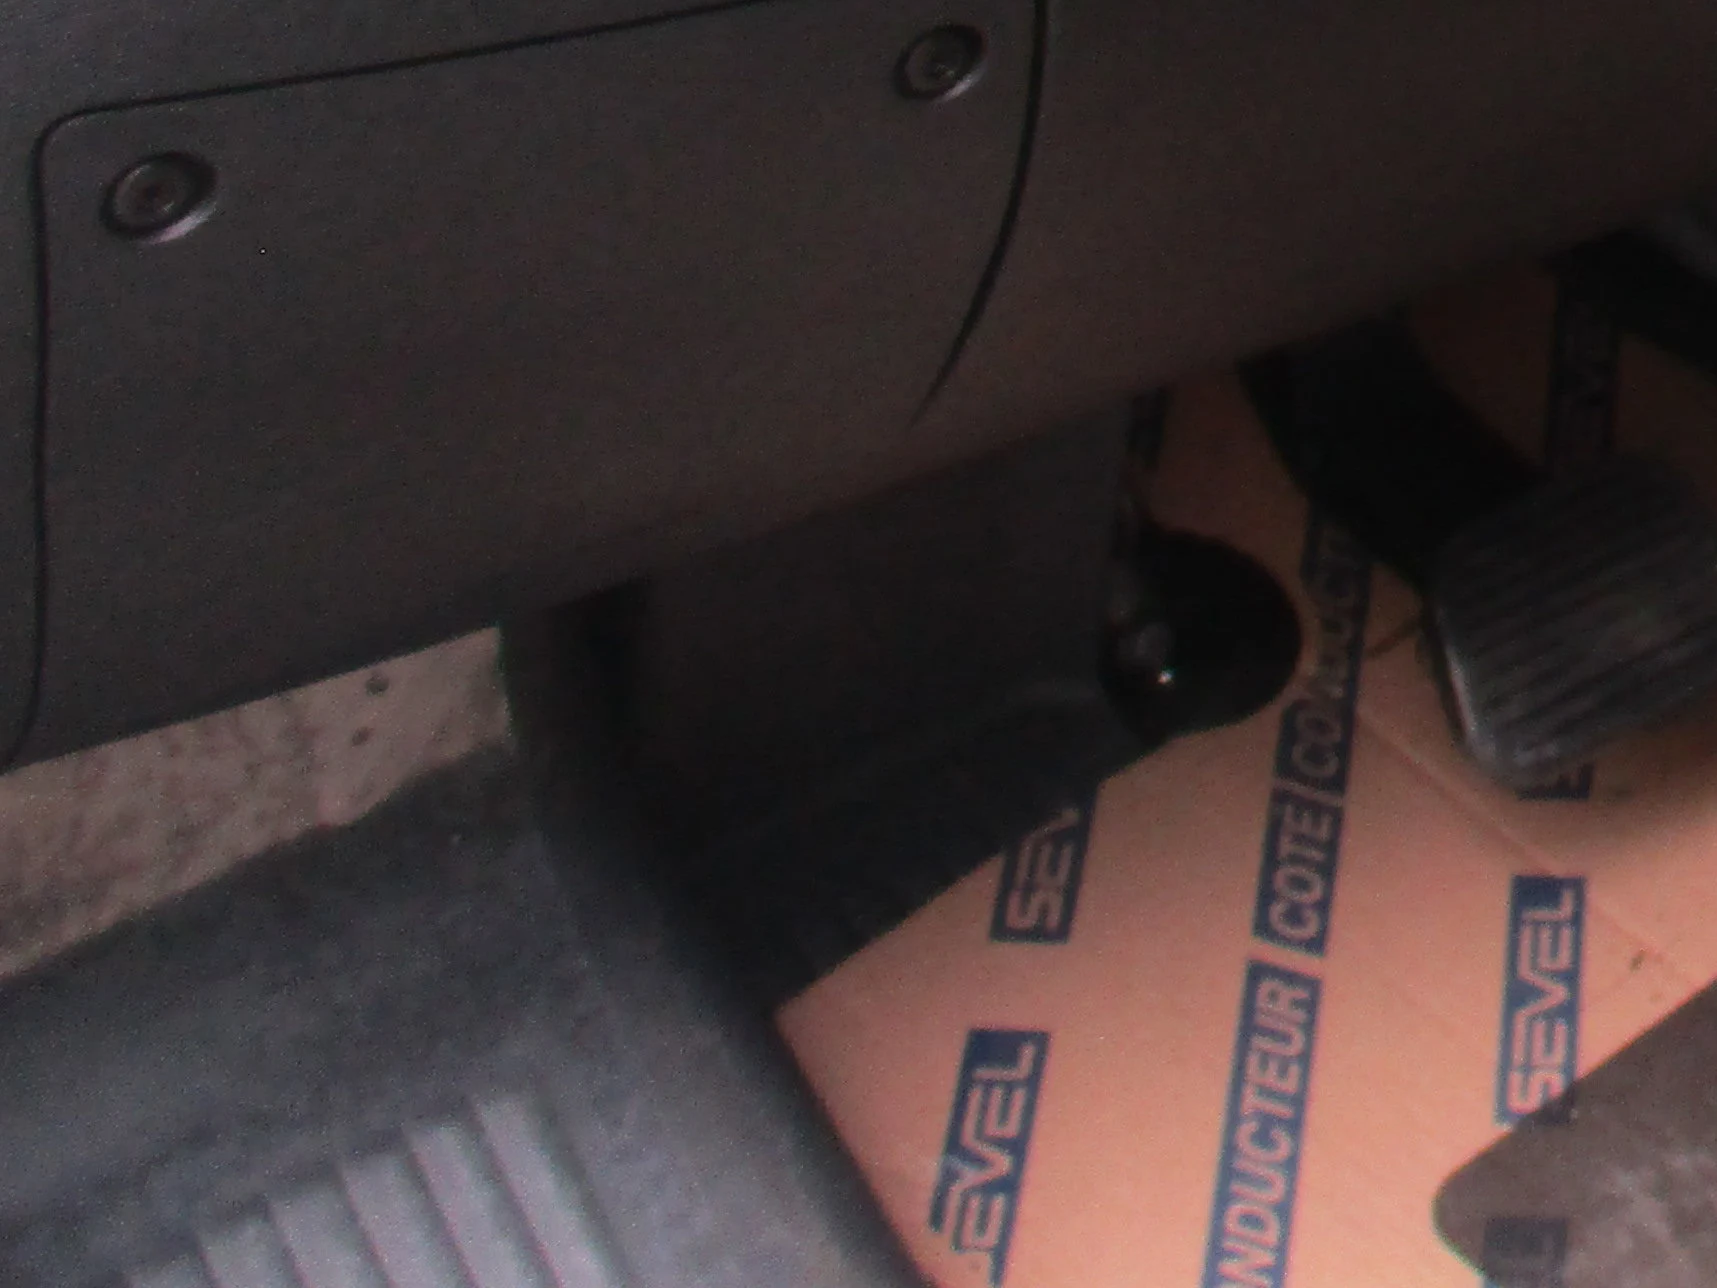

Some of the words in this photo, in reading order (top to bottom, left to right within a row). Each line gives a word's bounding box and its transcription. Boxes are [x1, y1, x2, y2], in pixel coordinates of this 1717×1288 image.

[1268, 805, 1336, 942] COTE
[1506, 888, 1574, 1117] SEVEL
[1217, 976, 1311, 1288] NDUCTEUR
